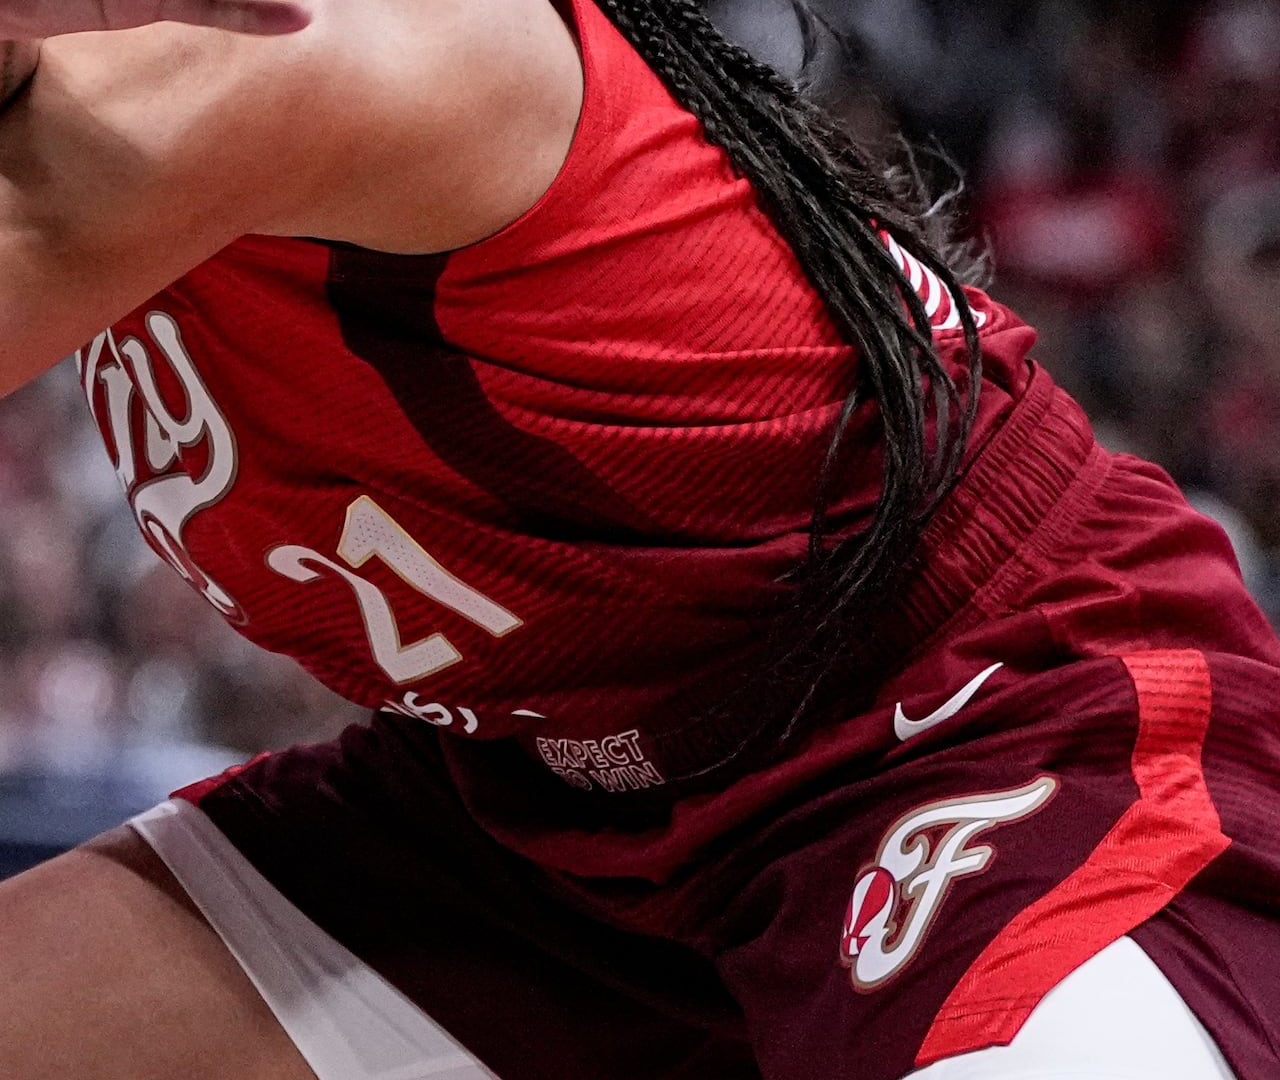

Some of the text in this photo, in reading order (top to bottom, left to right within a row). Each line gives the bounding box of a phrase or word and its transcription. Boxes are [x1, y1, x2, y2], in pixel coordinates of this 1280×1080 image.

[264, 494, 524, 684] 21
[536, 729, 644, 768] EXPECT
[588, 761, 666, 792] WIN
